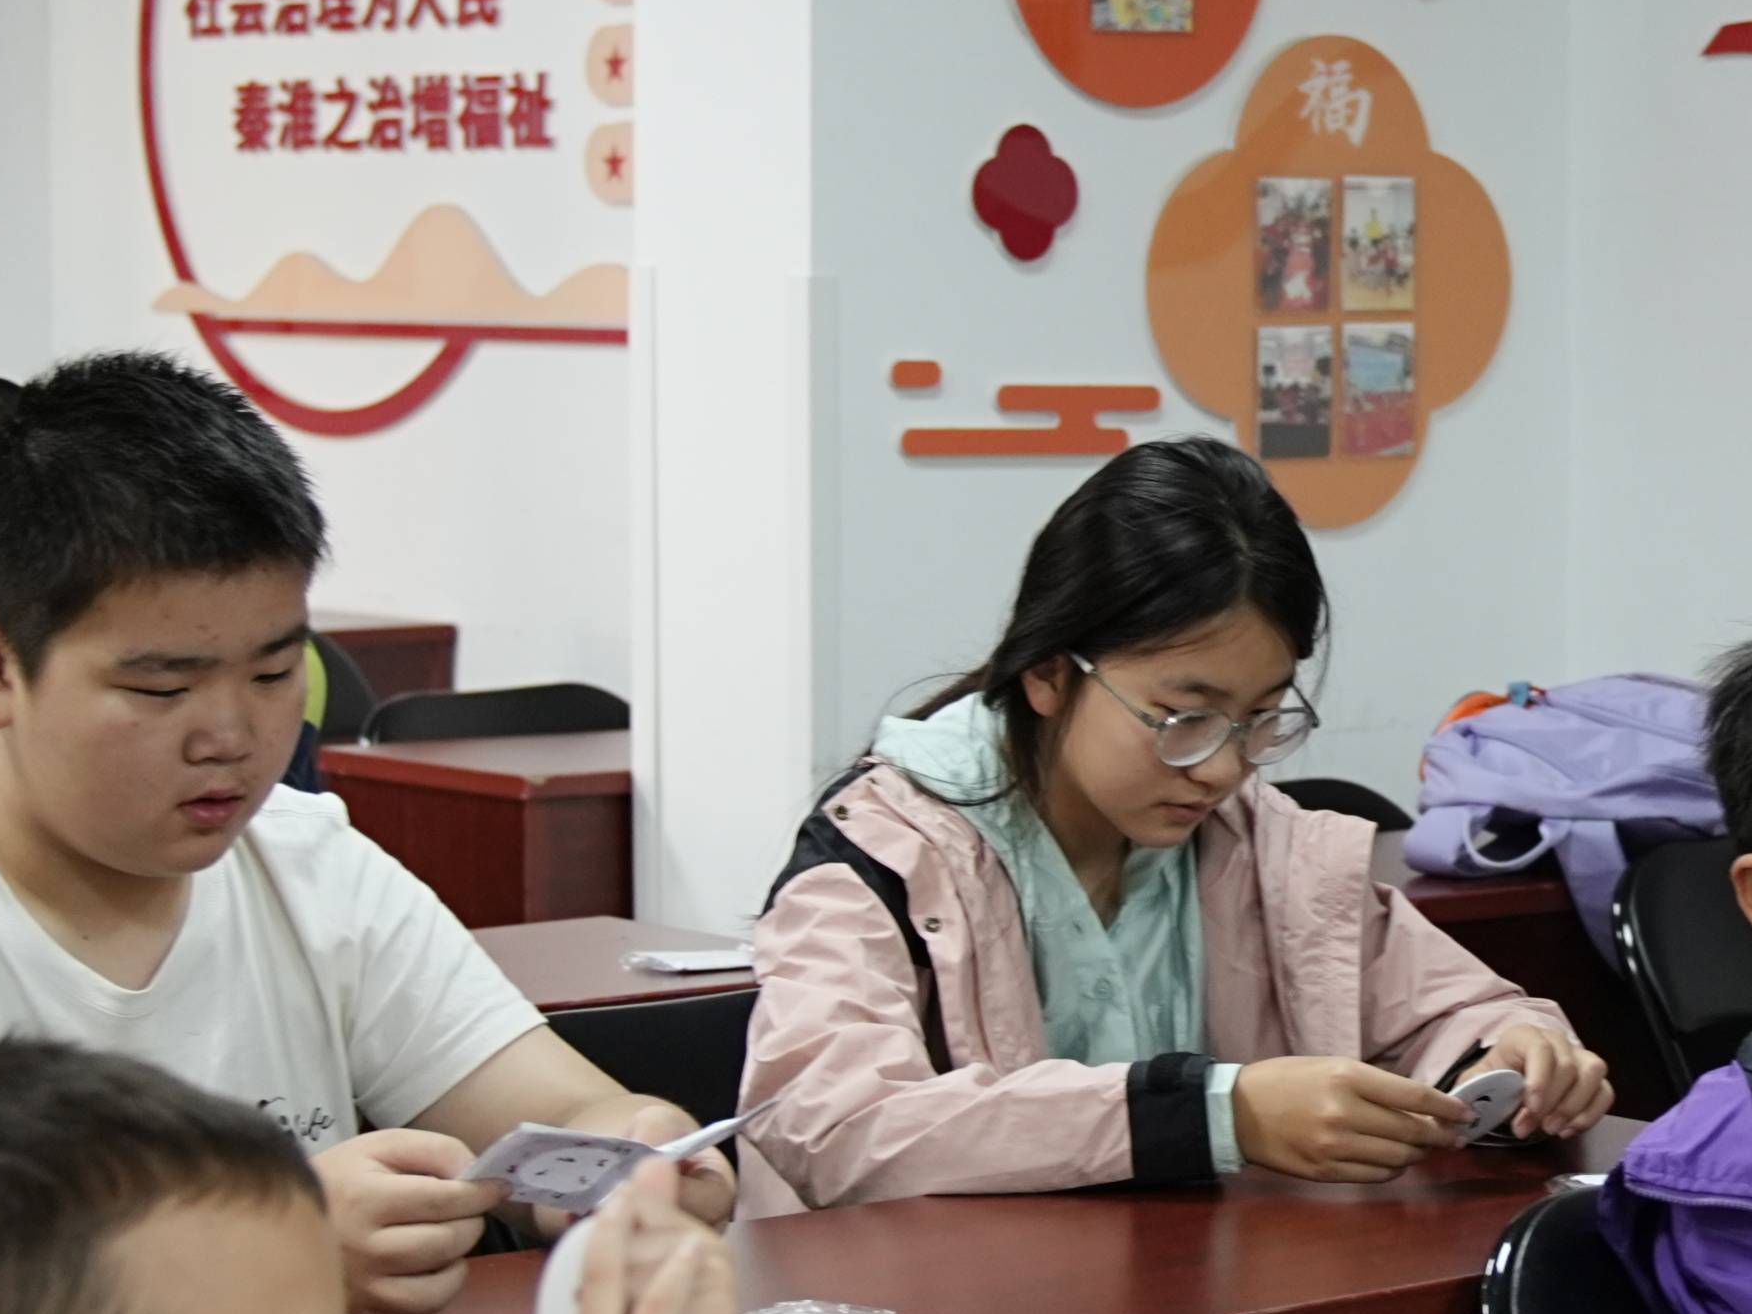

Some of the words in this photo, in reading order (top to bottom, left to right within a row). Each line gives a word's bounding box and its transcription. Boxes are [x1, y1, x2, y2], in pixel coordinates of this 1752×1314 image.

[231, 71, 556, 155] 秦淮之治增福祉
[1298, 58, 1373, 146] 福
